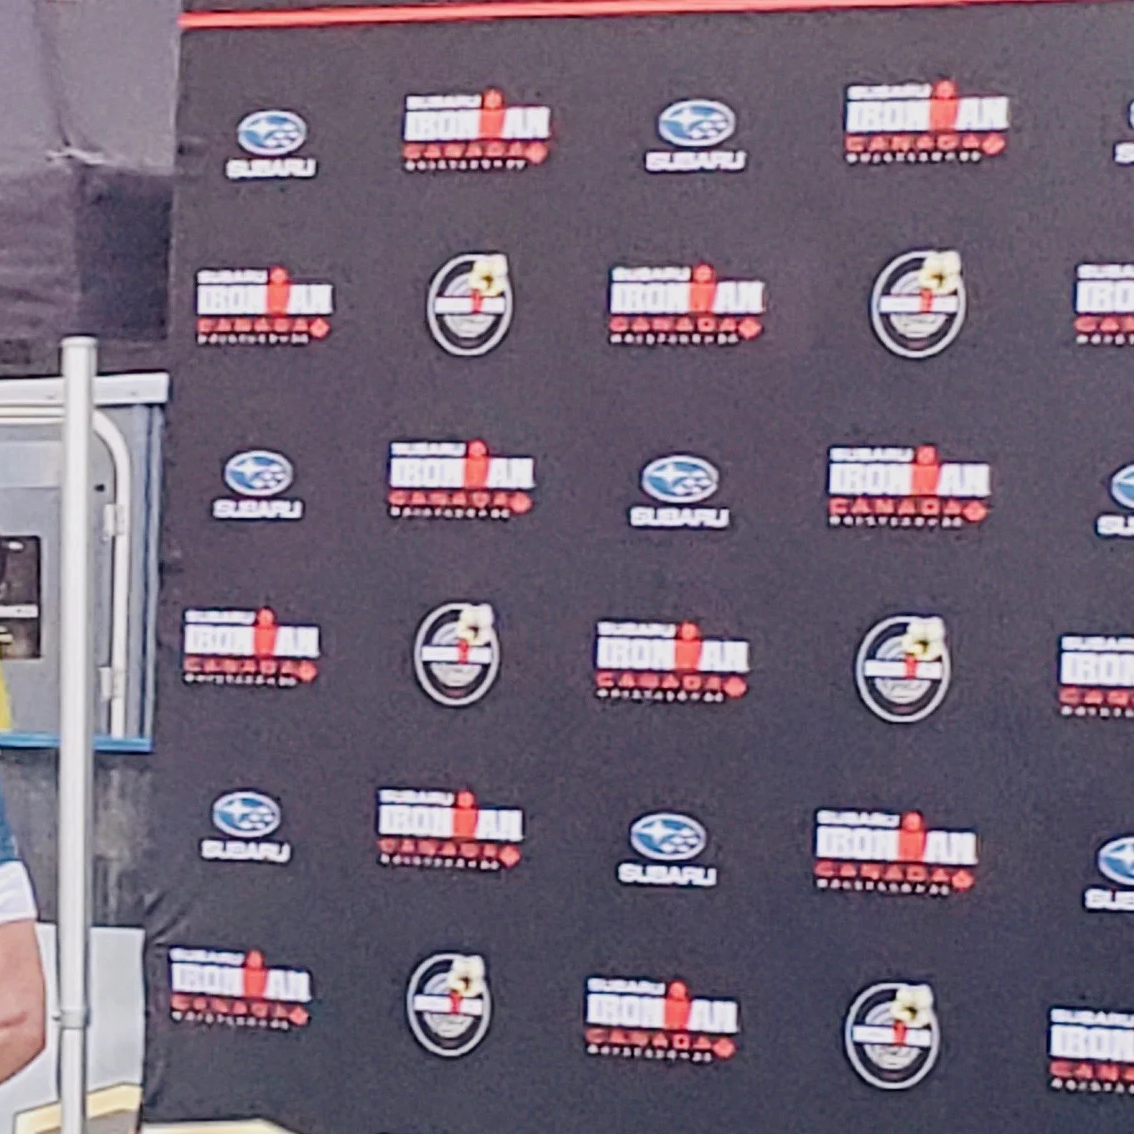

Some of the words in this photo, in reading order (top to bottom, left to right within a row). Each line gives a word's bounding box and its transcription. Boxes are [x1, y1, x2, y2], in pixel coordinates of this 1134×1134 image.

[405, 89, 550, 141] IRONMAN
[847, 80, 1009, 133] IRONMAN
[227, 159, 316, 178] SUBARU
[646, 151, 746, 171] SUBARU
[197, 267, 332, 315] IRONMAN
[610, 264, 764, 314] IRONMAN
[390, 440, 535, 488] IRONMAN
[829, 446, 991, 496] IRONMAN
[215, 499, 303, 518] SUBARU
[630, 507, 729, 527] SUBARU
[184, 609, 319, 658] IRONMAN
[597, 621, 749, 673] IRONMAN
[1060, 652, 1134, 687] IRON
[379, 789, 523, 842] IRONMAN
[816, 809, 977, 865] IRONMAN
[202, 840, 290, 862] SUBARU
[619, 863, 716, 886] SUBARU
[1085, 889, 1134, 911] SUB
[171, 951, 310, 1002] IRONMAN
[587, 982, 737, 1033] IRONMAN
[1050, 1025, 1134, 1063] IRON
